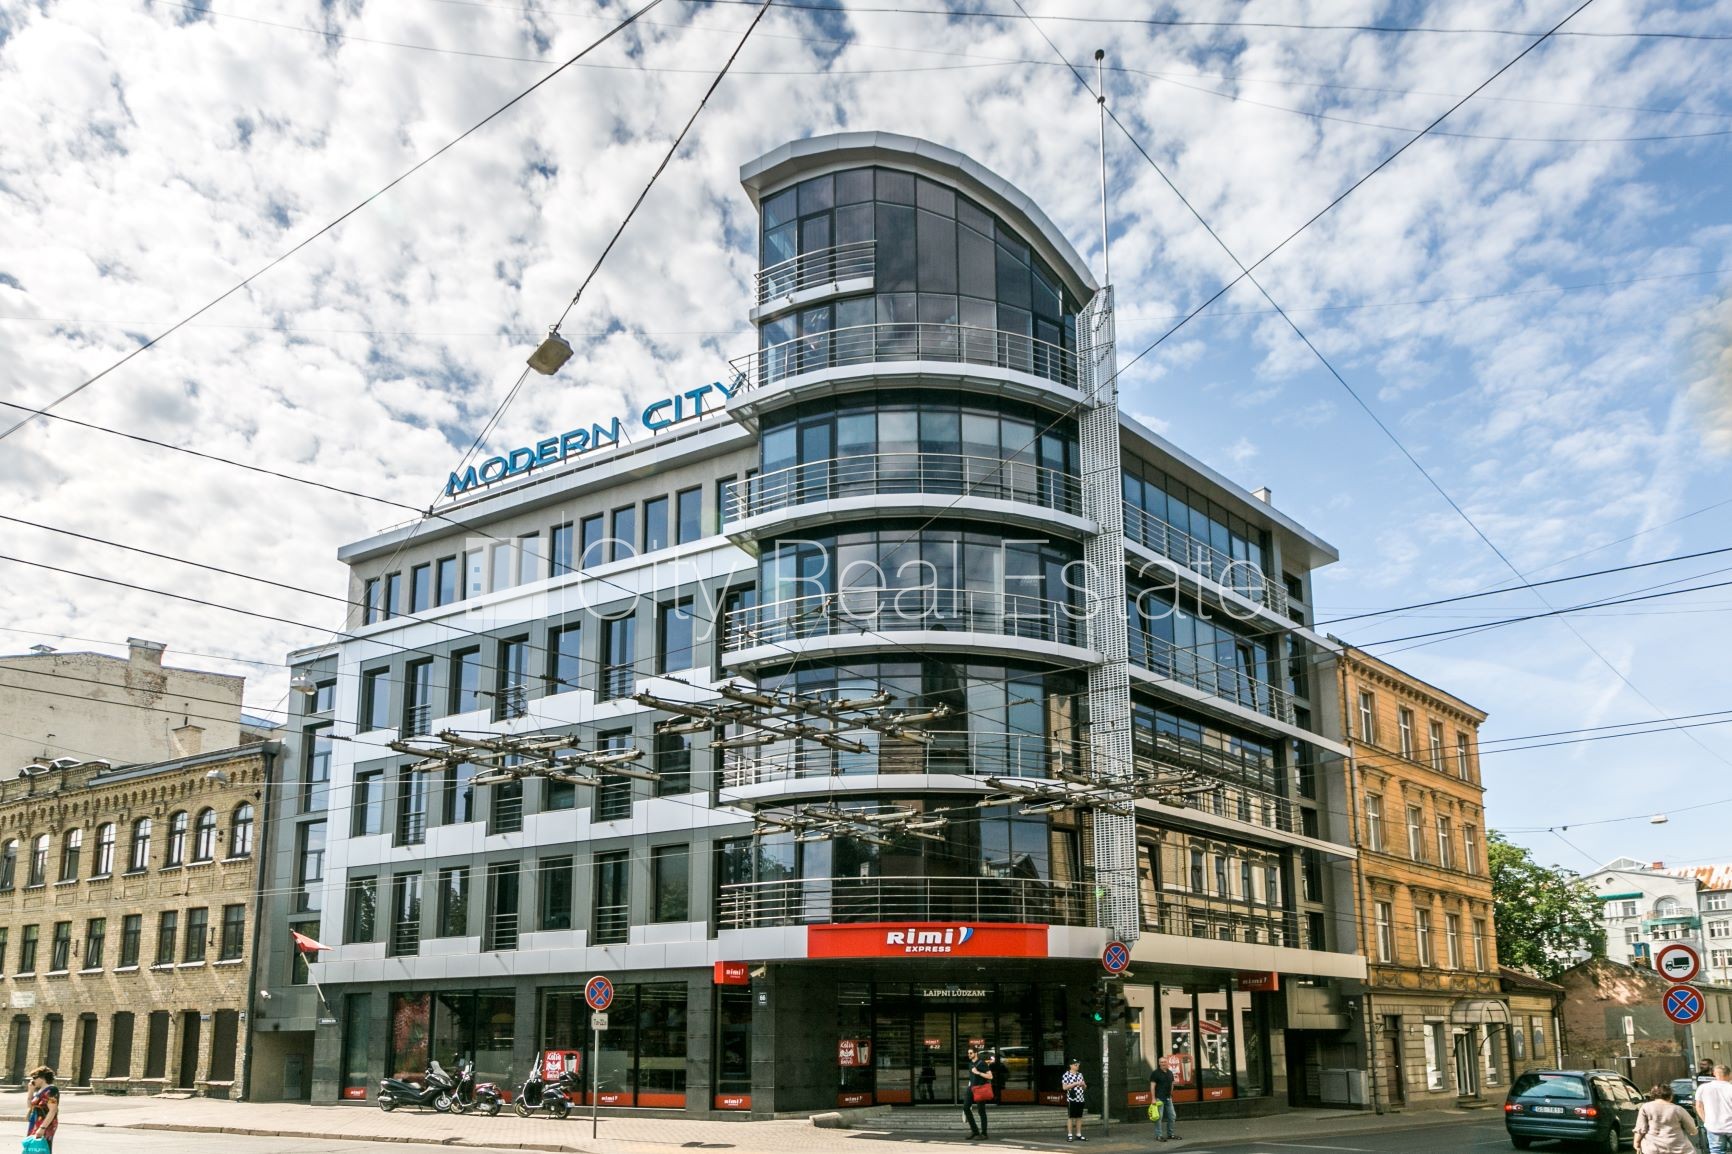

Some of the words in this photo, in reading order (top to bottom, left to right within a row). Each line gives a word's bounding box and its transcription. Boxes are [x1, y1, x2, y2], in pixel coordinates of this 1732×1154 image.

[445, 416, 620, 497] MODERN
[642, 371, 747, 430] CITY
[886, 928, 954, 945] Rimi
[905, 945, 952, 953] EXPRESS
